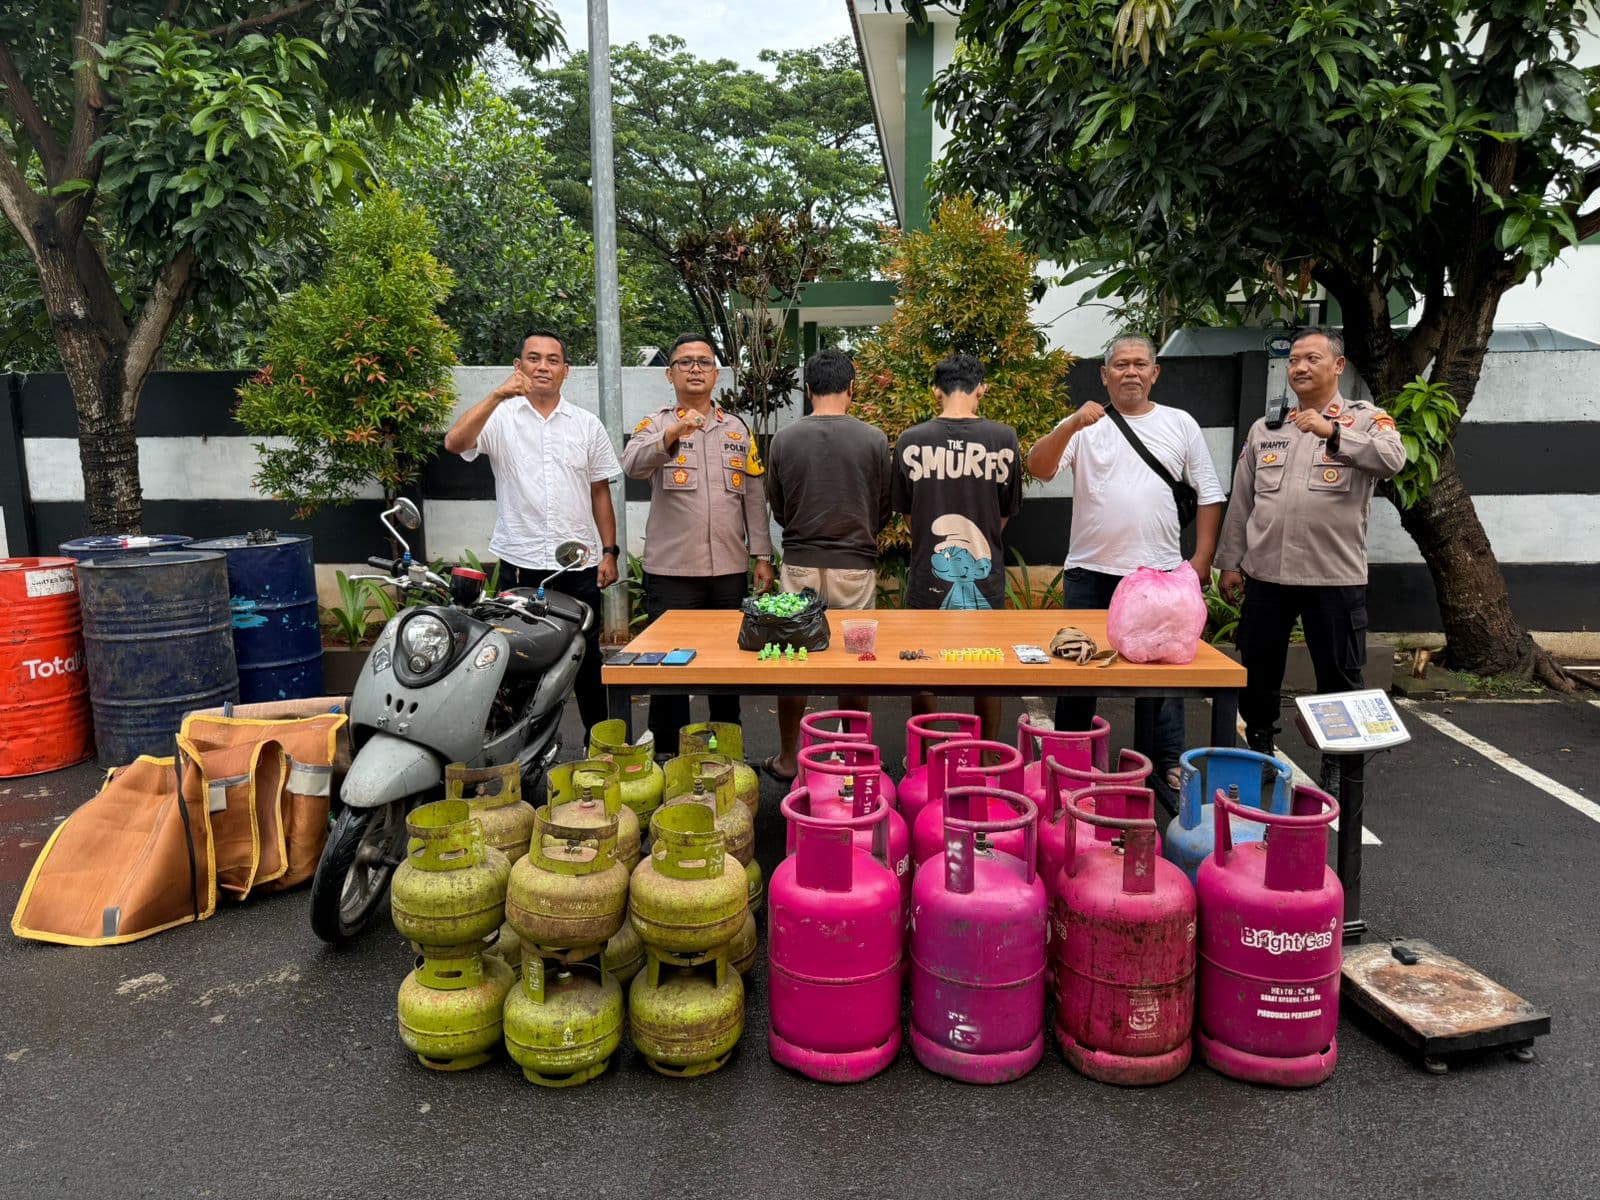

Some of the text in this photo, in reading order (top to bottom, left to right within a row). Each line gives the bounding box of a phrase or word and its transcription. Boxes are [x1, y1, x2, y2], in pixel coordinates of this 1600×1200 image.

[724, 443, 747, 453] POLRI
[946, 439, 964, 450] THE
[1260, 440, 1289, 449] WAHYU
[902, 442, 1015, 483] SMURFS
[22, 652, 81, 680] Total
[1241, 926, 1332, 955] Bright Gas
